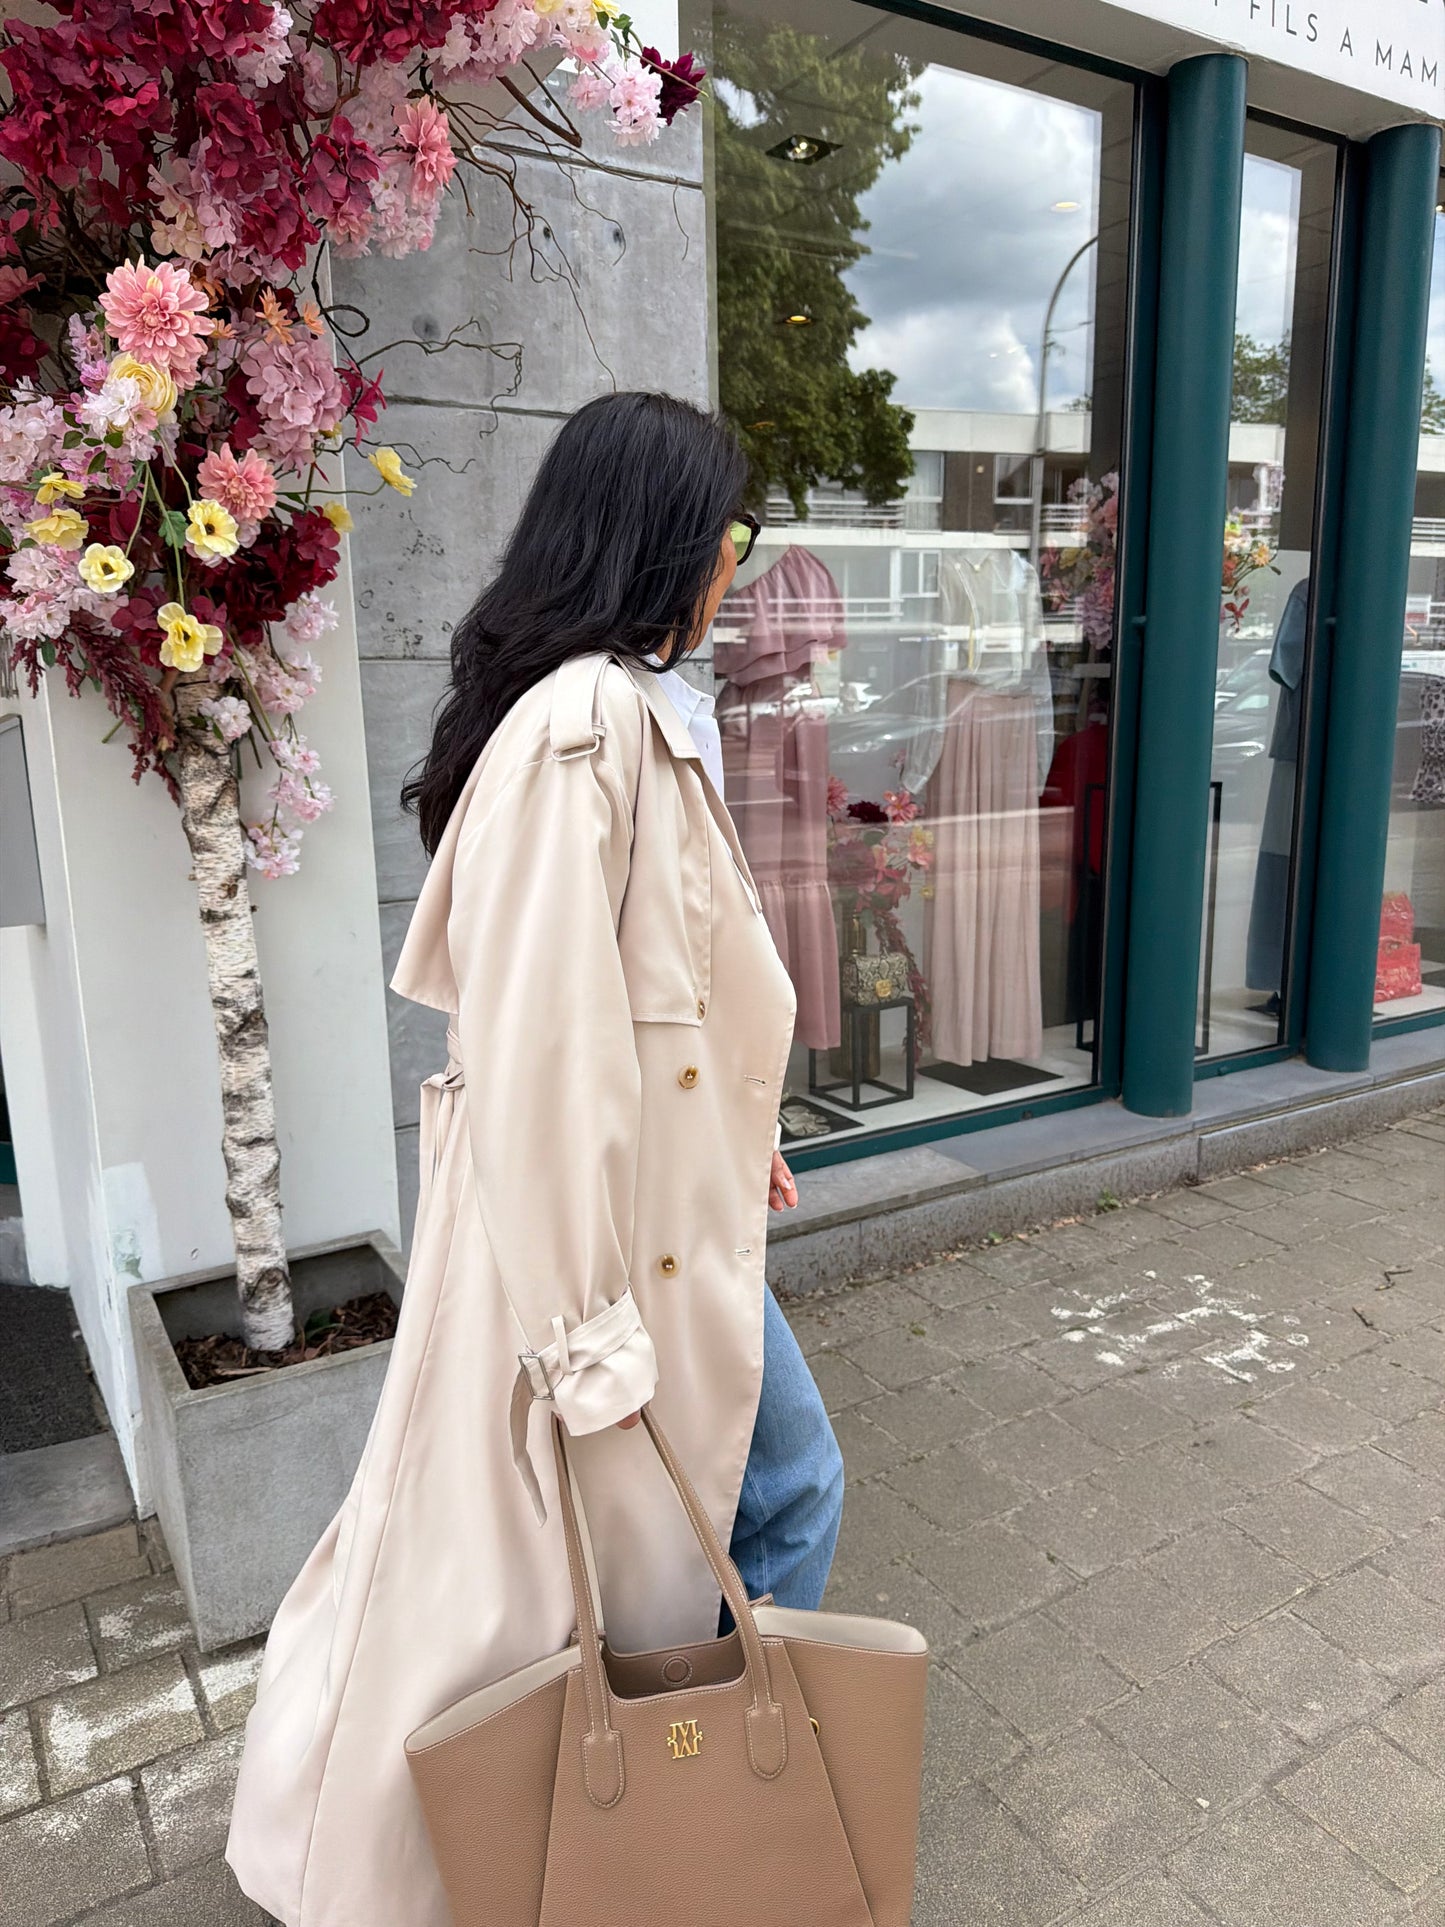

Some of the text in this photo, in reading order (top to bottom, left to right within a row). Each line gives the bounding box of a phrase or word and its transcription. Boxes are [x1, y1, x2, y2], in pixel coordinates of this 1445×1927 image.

[1249, 0, 1438, 87] FILS A MAM
